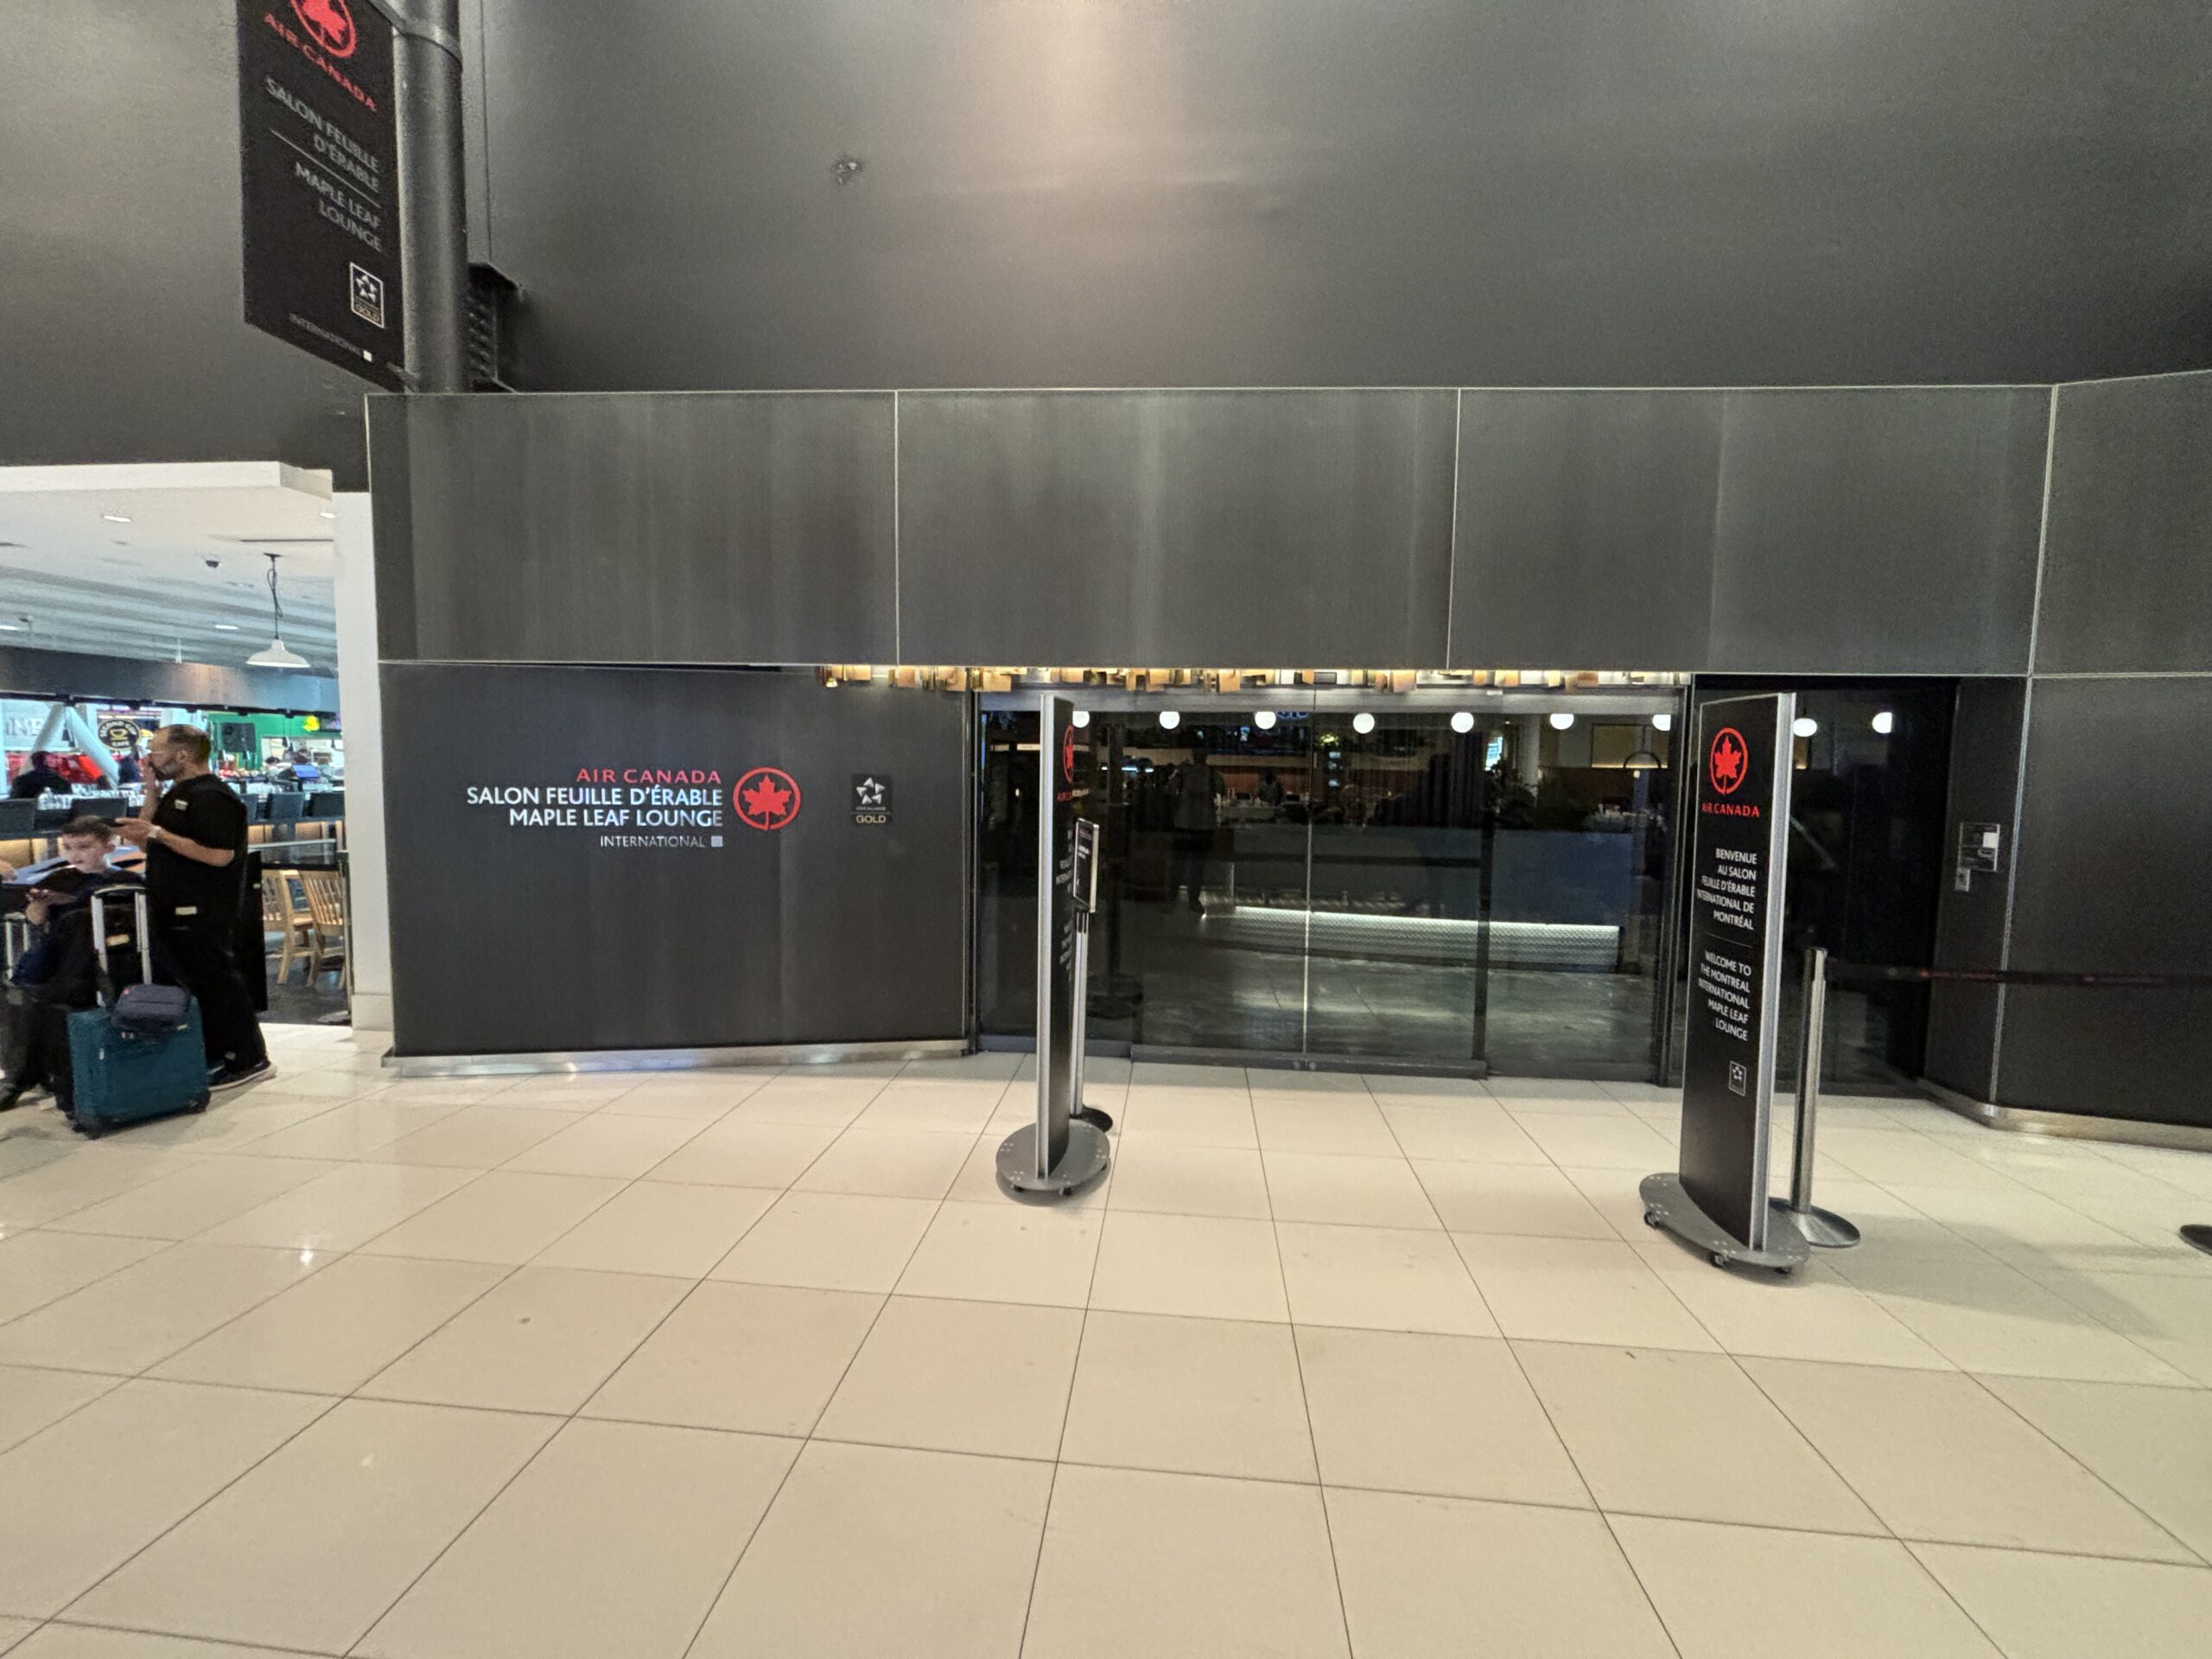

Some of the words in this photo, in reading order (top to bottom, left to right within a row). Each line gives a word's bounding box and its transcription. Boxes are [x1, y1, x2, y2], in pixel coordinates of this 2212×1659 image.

[264, 14, 300, 48] AIR
[302, 45, 378, 111] CANADA
[266, 76, 322, 130] SALON
[326, 122, 379, 173] FEUILLE
[295, 162, 346, 208] MAPLE
[349, 199, 381, 228] LEAF
[318, 198, 381, 252] LOUNGE
[355, 304, 380, 322] GOLD
[99, 721, 124, 737] SECOND
[576, 768, 615, 782] AIR
[623, 769, 721, 784] CANADA
[467, 787, 539, 804] SALON
[546, 788, 621, 805] FEUILLE
[630, 785, 722, 806] D'ÉRABLE
[510, 809, 576, 827] MAPLE
[583, 810, 630, 827] LEAF
[637, 810, 722, 827] LOUNGE
[856, 815, 886, 823] GOLD
[1714, 803, 1759, 817] CANADA
[601, 836, 705, 848] INTERNATIONAL
[1716, 848, 1758, 865] BIENVENUE
[1701, 874, 1720, 890] FEUILLE
[1718, 864, 1727, 875] AU
[1729, 867, 1756, 880] SALON
[1696, 888, 1741, 912] INTERNATIONAL
[1743, 901, 1754, 913] DE
[1713, 909, 1754, 931] MONTRÉAL
[1705, 950, 1737, 972] WELCOME
[1738, 963, 1751, 976] TO
[1700, 963, 1710, 977] THE
[1711, 969, 1751, 993] MONTREAL
[1698, 977, 1750, 1009] INTERNATIONAL
[1707, 998, 1728, 1016] MAPLE
[1730, 1007, 1749, 1025] LEAF
[1715, 1017, 1748, 1042] LOUNGE
